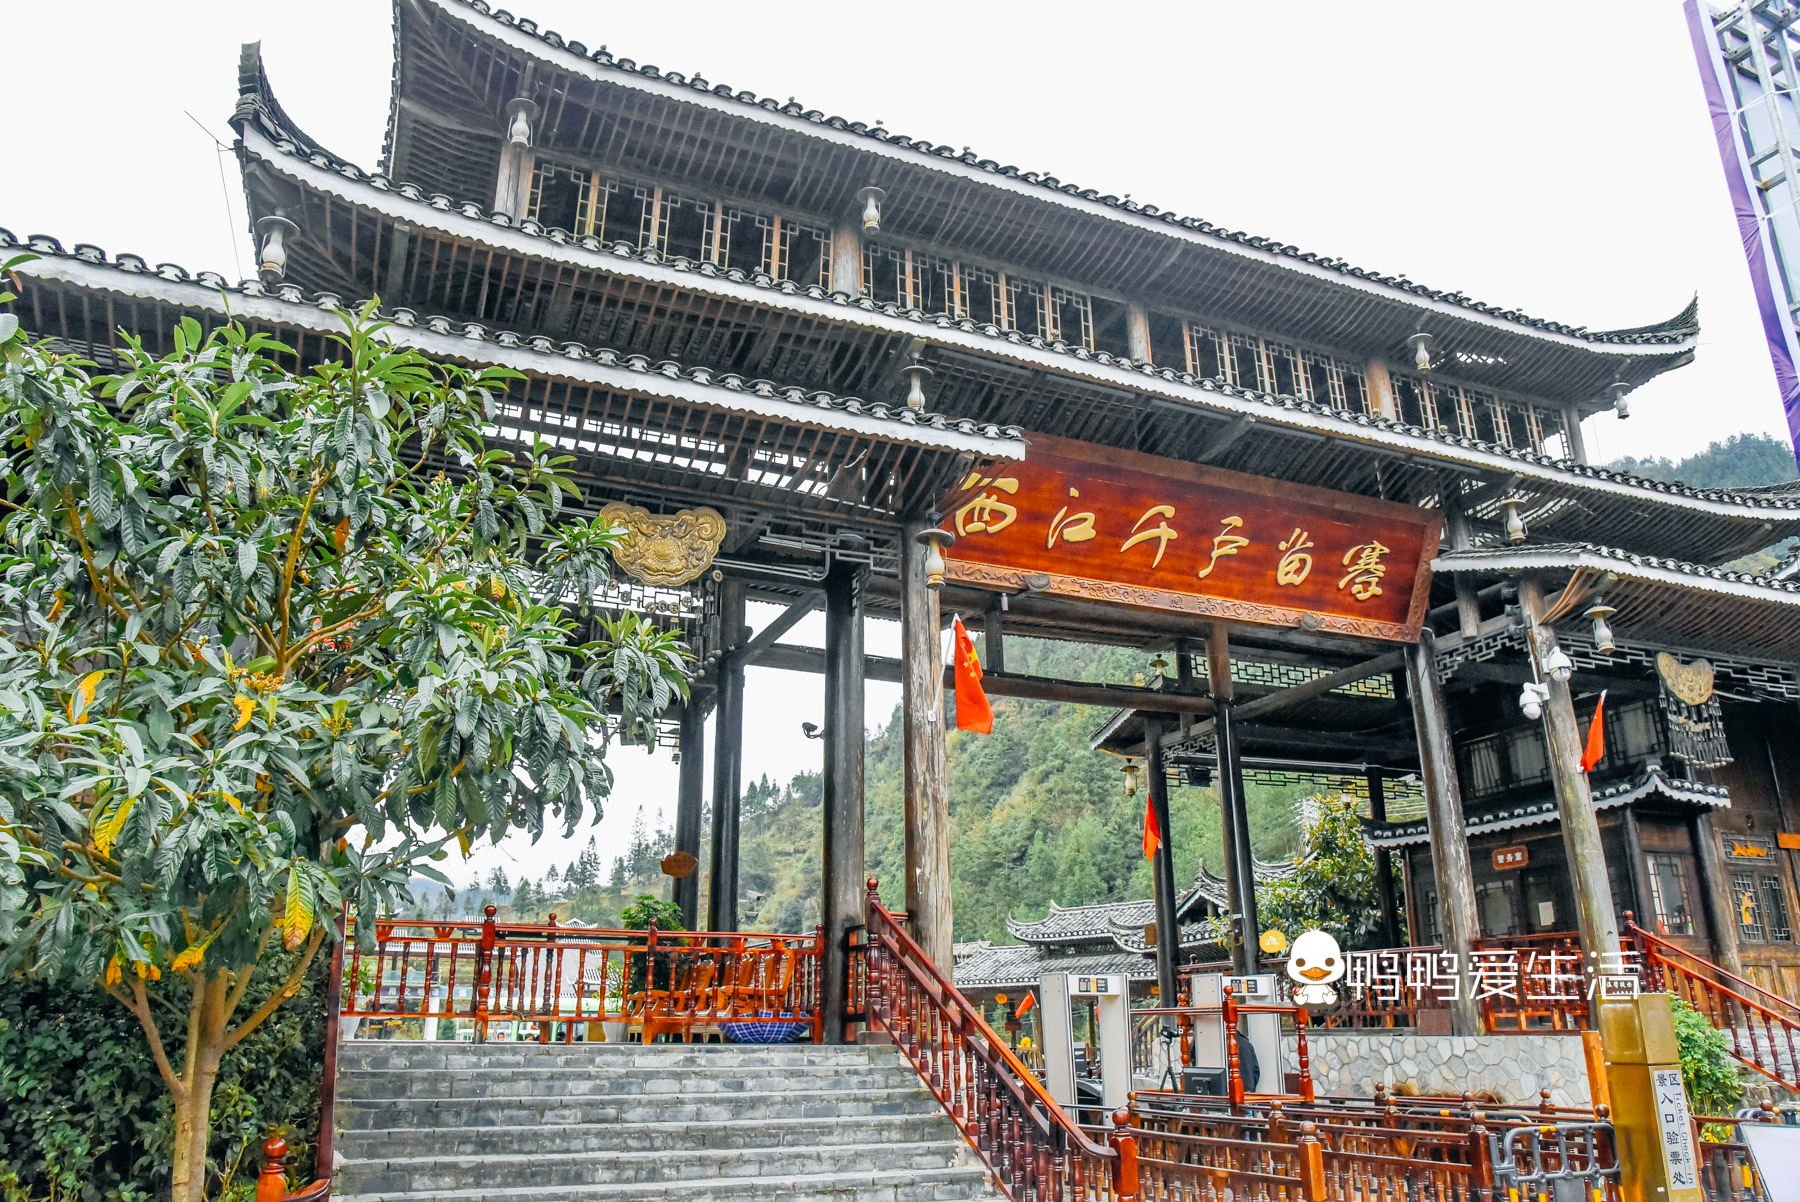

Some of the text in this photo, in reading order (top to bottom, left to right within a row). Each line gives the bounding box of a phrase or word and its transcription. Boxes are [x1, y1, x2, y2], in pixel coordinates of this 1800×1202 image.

[955, 471, 1390, 601] 西江千户苗寨
[1656, 1073, 1681, 1087] 景区
[1660, 1092, 1686, 1186] 入口验票处
[1674, 1092, 1694, 1184] Ticket Check-in
